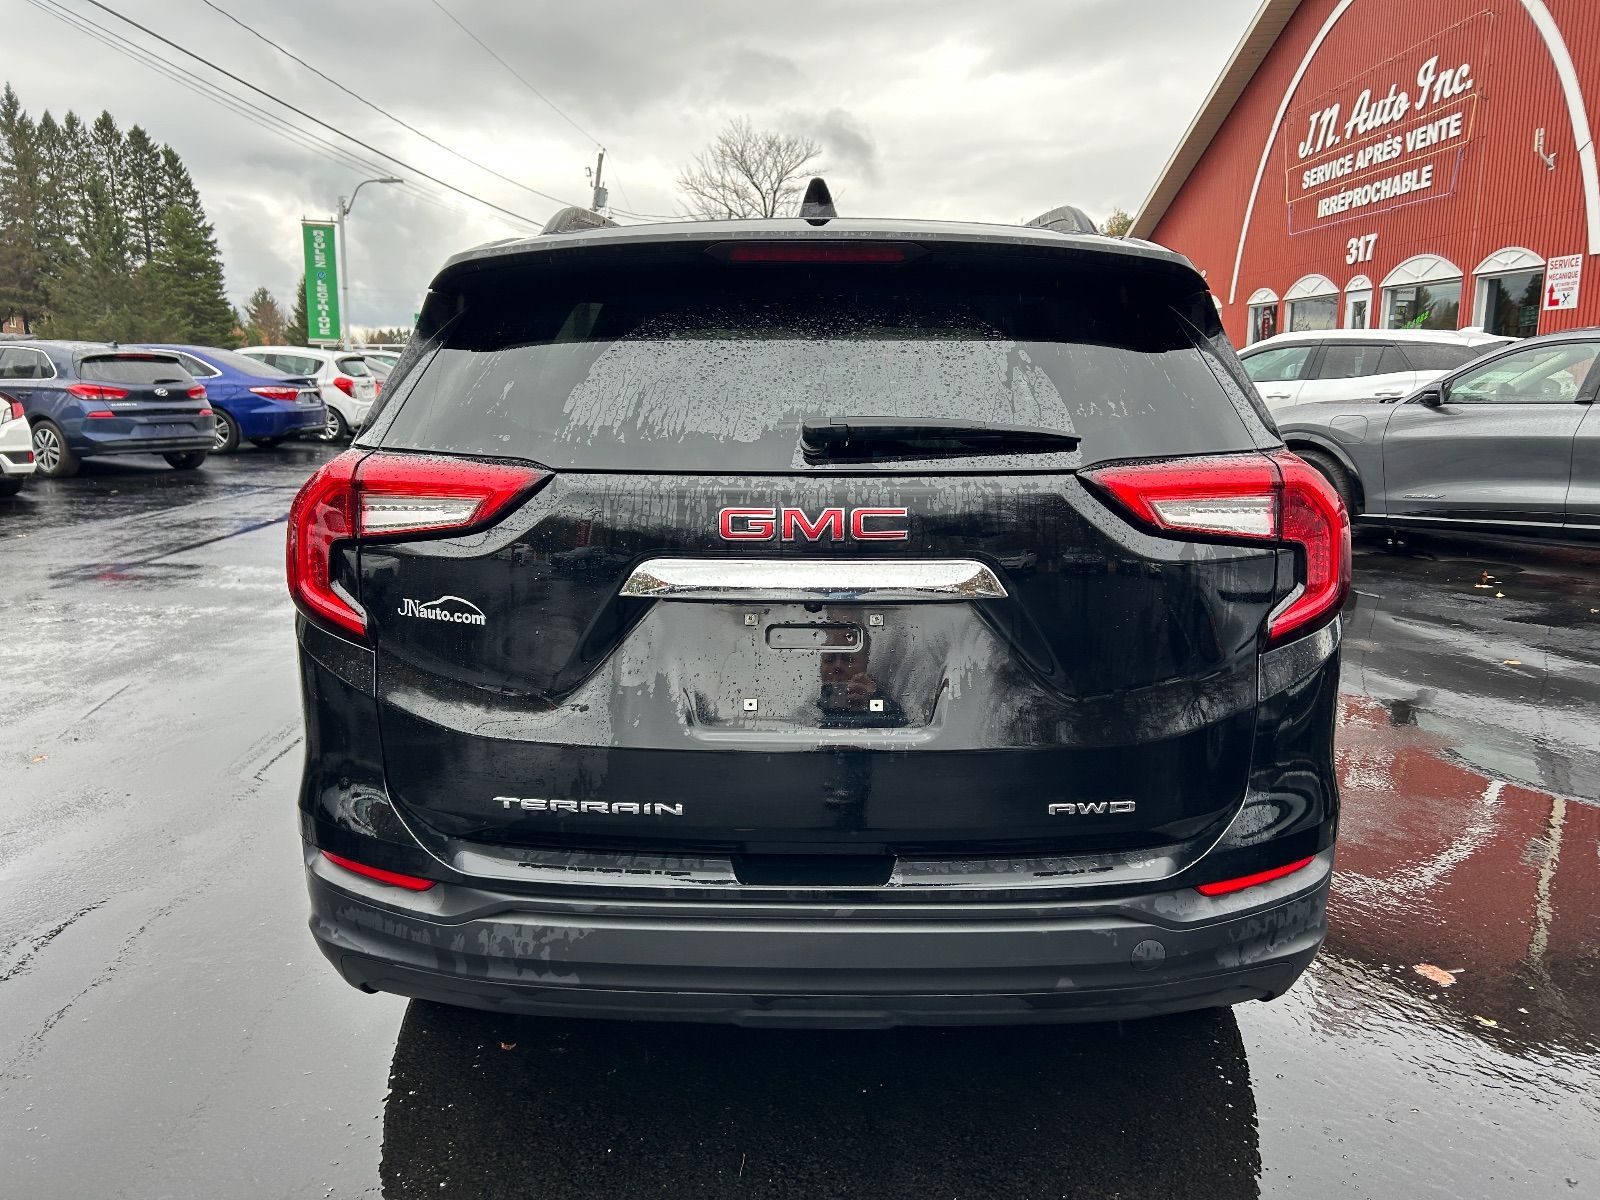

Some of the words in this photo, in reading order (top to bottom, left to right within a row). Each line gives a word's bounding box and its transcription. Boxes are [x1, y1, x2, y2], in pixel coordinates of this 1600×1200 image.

[1298, 103, 1341, 158] J.N.
[1344, 83, 1410, 139] Auto
[1414, 55, 1474, 111] Inc.
[1302, 153, 1354, 190] SERVICE
[1354, 134, 1402, 172] APRÈS
[1405, 112, 1462, 152] VENTE
[1317, 164, 1433, 218] IRRÉPROCHABLE
[1345, 232, 1377, 264] 317
[1549, 256, 1580, 270] SERVICE
[1548, 270, 1579, 281] MÉCANIQUE
[718, 507, 909, 541] GMC
[397, 597, 486, 625] JNauto.com
[493, 796, 684, 816] TERRAIN
[1048, 801, 1136, 815] AWD
